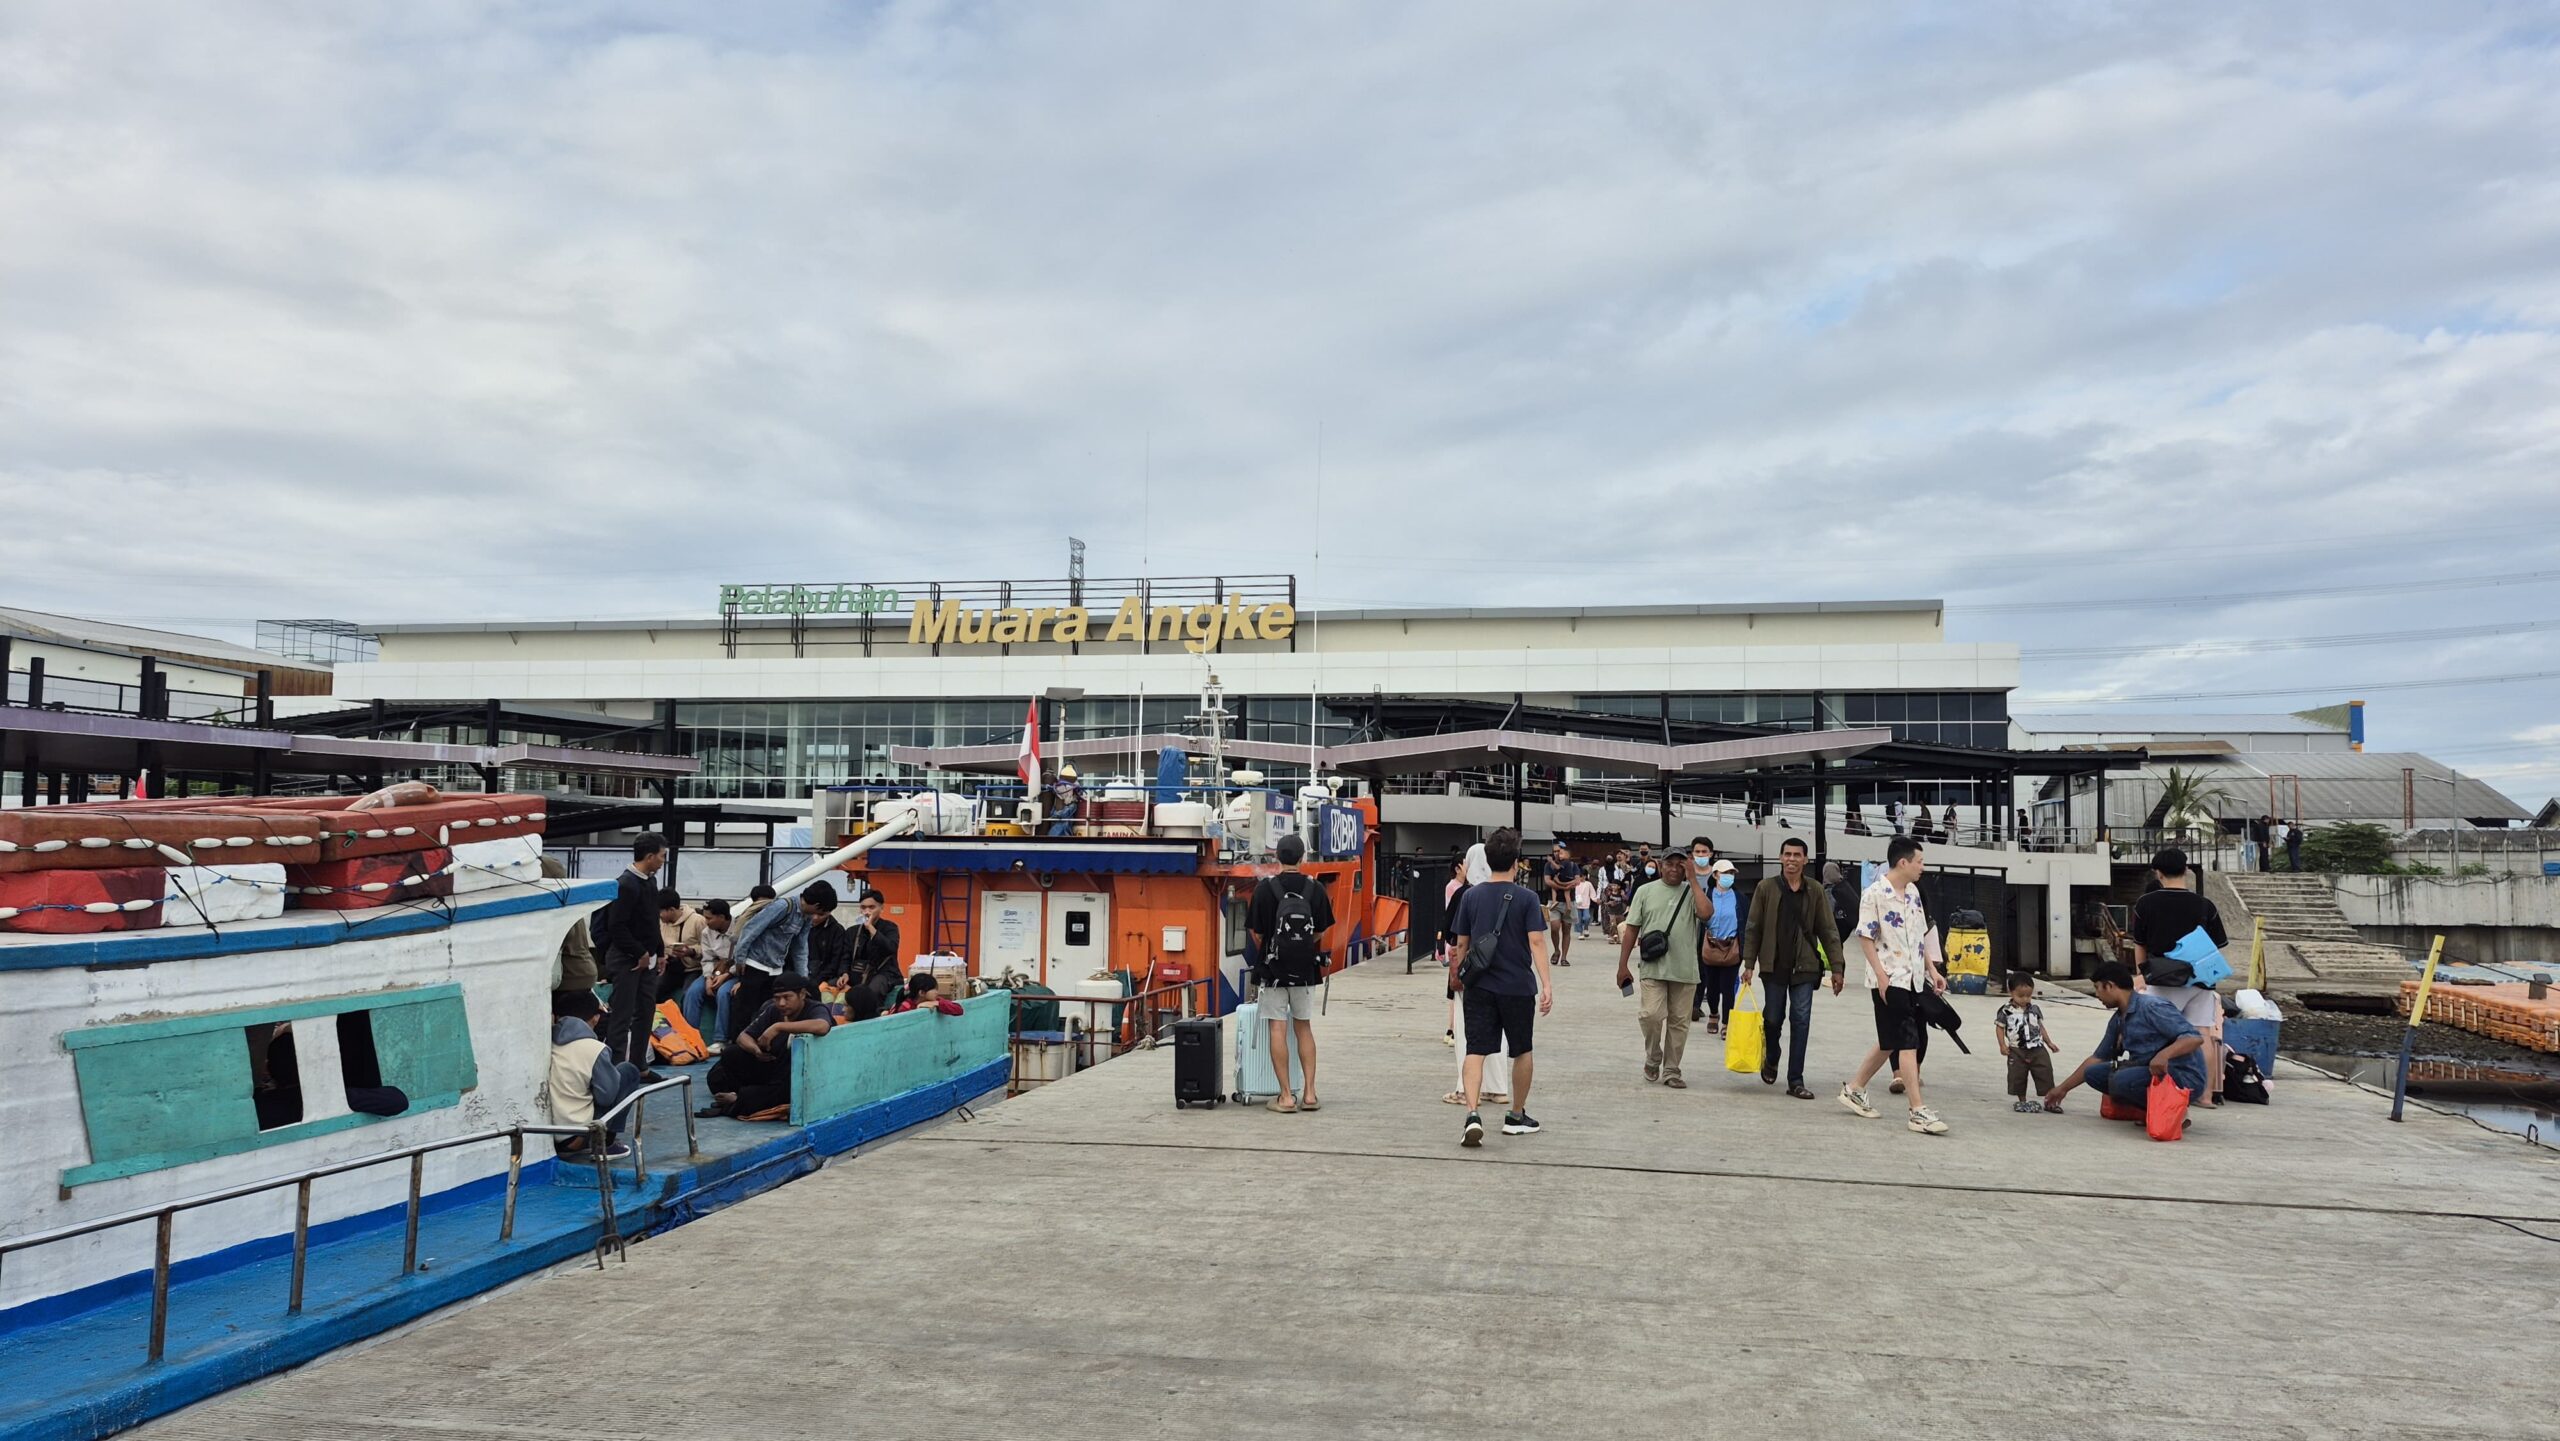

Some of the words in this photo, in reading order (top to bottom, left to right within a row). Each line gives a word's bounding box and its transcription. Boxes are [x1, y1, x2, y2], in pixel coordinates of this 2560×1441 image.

[718, 583, 900, 615] Pelabuhan
[908, 599, 1089, 644] Muara
[1105, 593, 1295, 652] Angke
[1272, 814, 1285, 830] ATM
[1340, 813, 1357, 851] BRI
